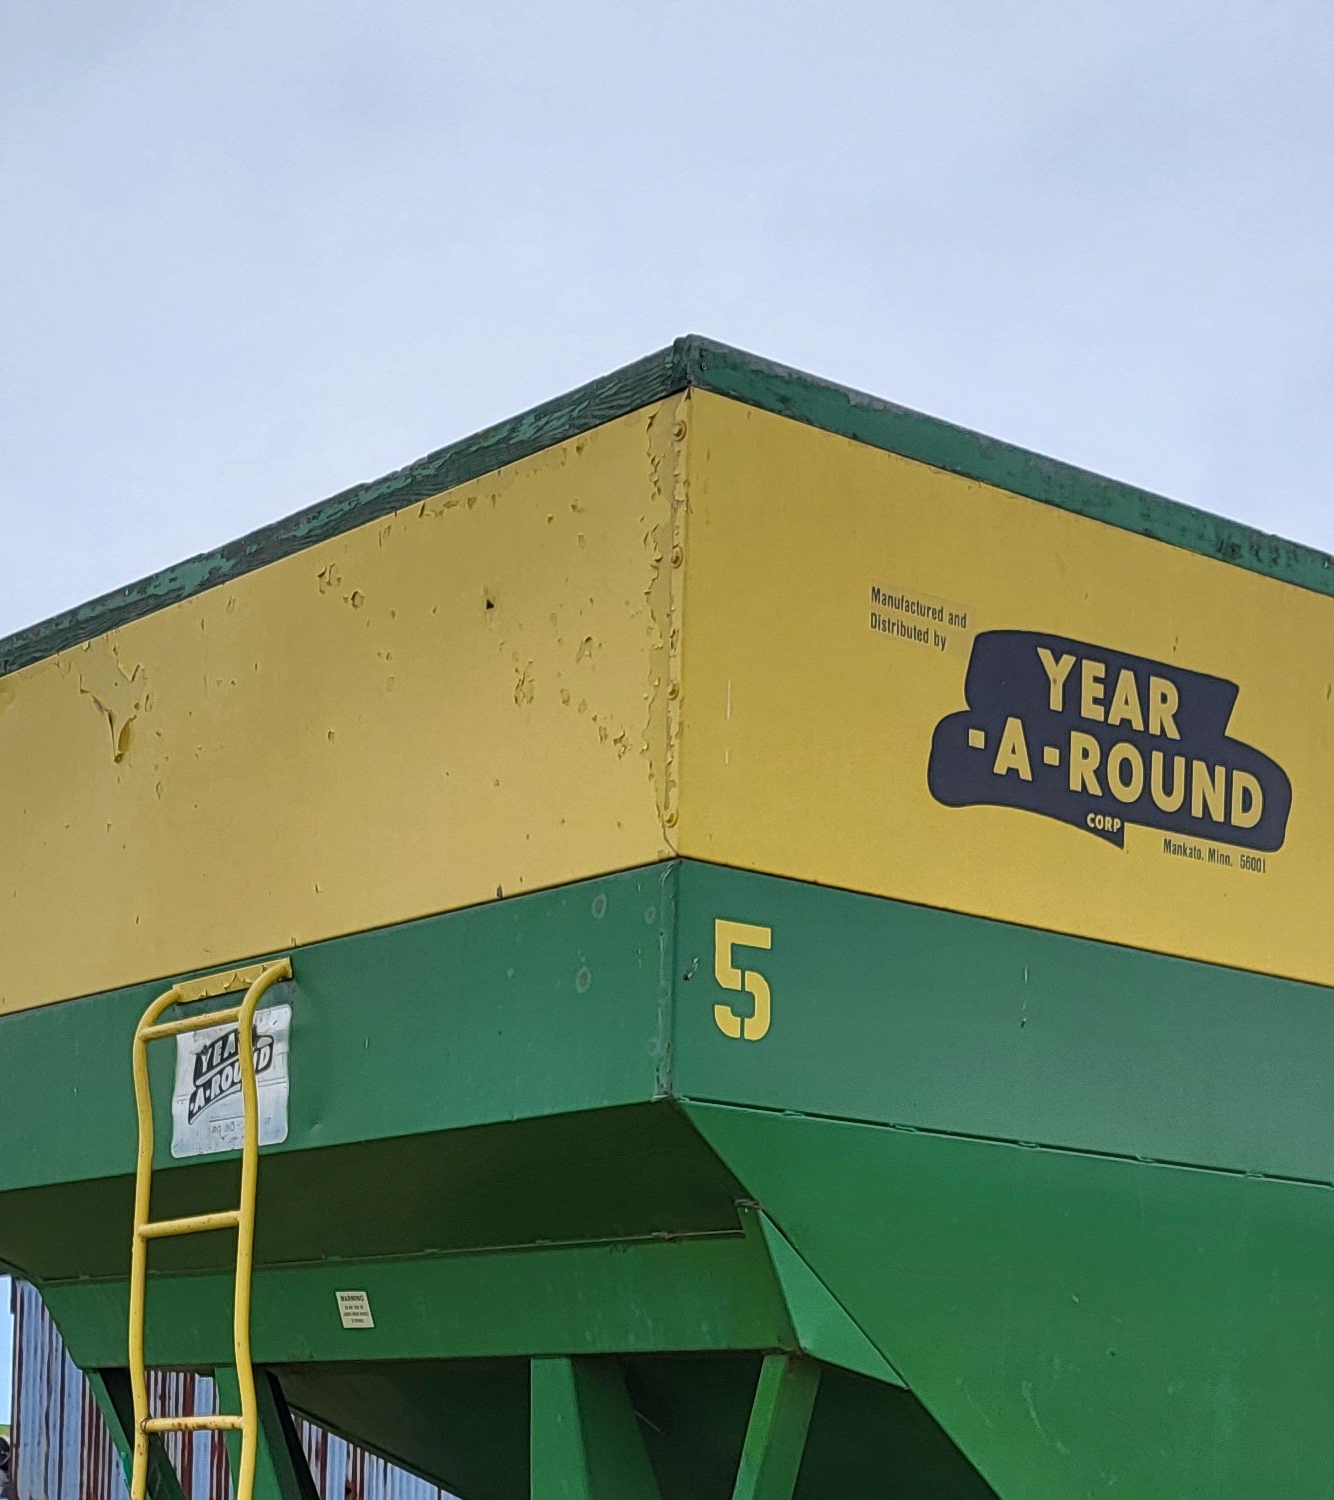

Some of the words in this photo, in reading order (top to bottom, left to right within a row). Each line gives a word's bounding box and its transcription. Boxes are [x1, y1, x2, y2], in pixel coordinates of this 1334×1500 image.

[871, 586, 944, 623] Manufactured
[948, 612, 968, 629] and
[870, 612, 930, 645] Distributed
[933, 630, 947, 652] by
[1036, 645, 1181, 741] YEAR
[1086, 812, 1122, 834] CORP
[1239, 854, 1266, 874] 56001
[714, 918, 772, 1041] 5
[200, 1029, 244, 1075] YEA
